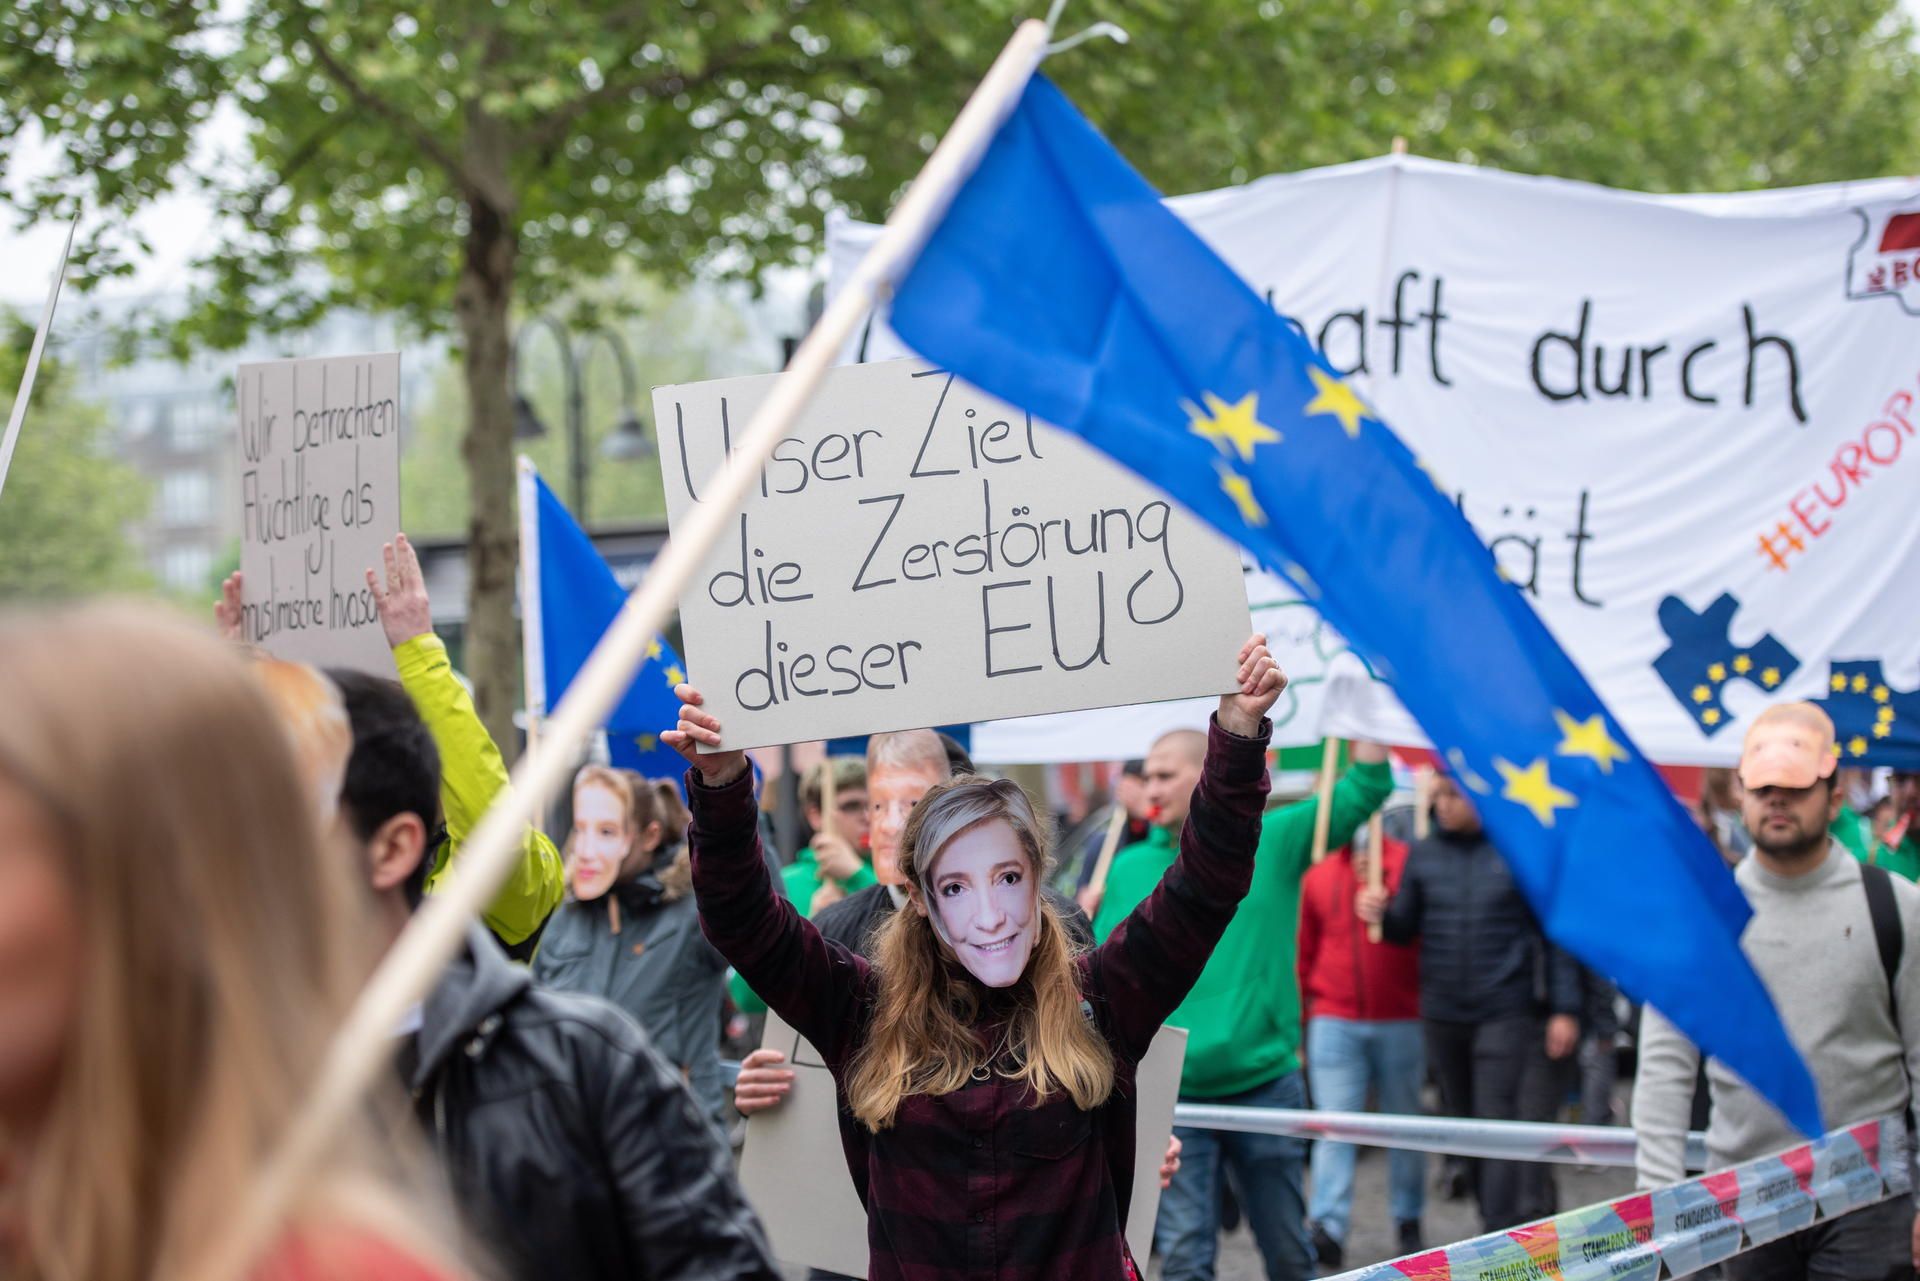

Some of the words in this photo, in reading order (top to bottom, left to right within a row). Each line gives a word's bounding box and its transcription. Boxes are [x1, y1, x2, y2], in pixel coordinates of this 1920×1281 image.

[240, 371, 277, 463] Wir
[293, 363, 395, 453] betrachten
[1530, 298, 1806, 422] durch
[341, 443, 374, 529] als
[675, 397, 883, 503] User
[909, 370, 1043, 478] Ziel
[1758, 372, 1920, 573] #EUROP
[709, 513, 813, 607] die
[852, 479, 1184, 625] Zerstörung
[1456, 488, 1603, 607] ät
[735, 620, 923, 711] dieser
[982, 571, 1111, 678] EU
[1582, 1231, 1626, 1263] STANDARDS
